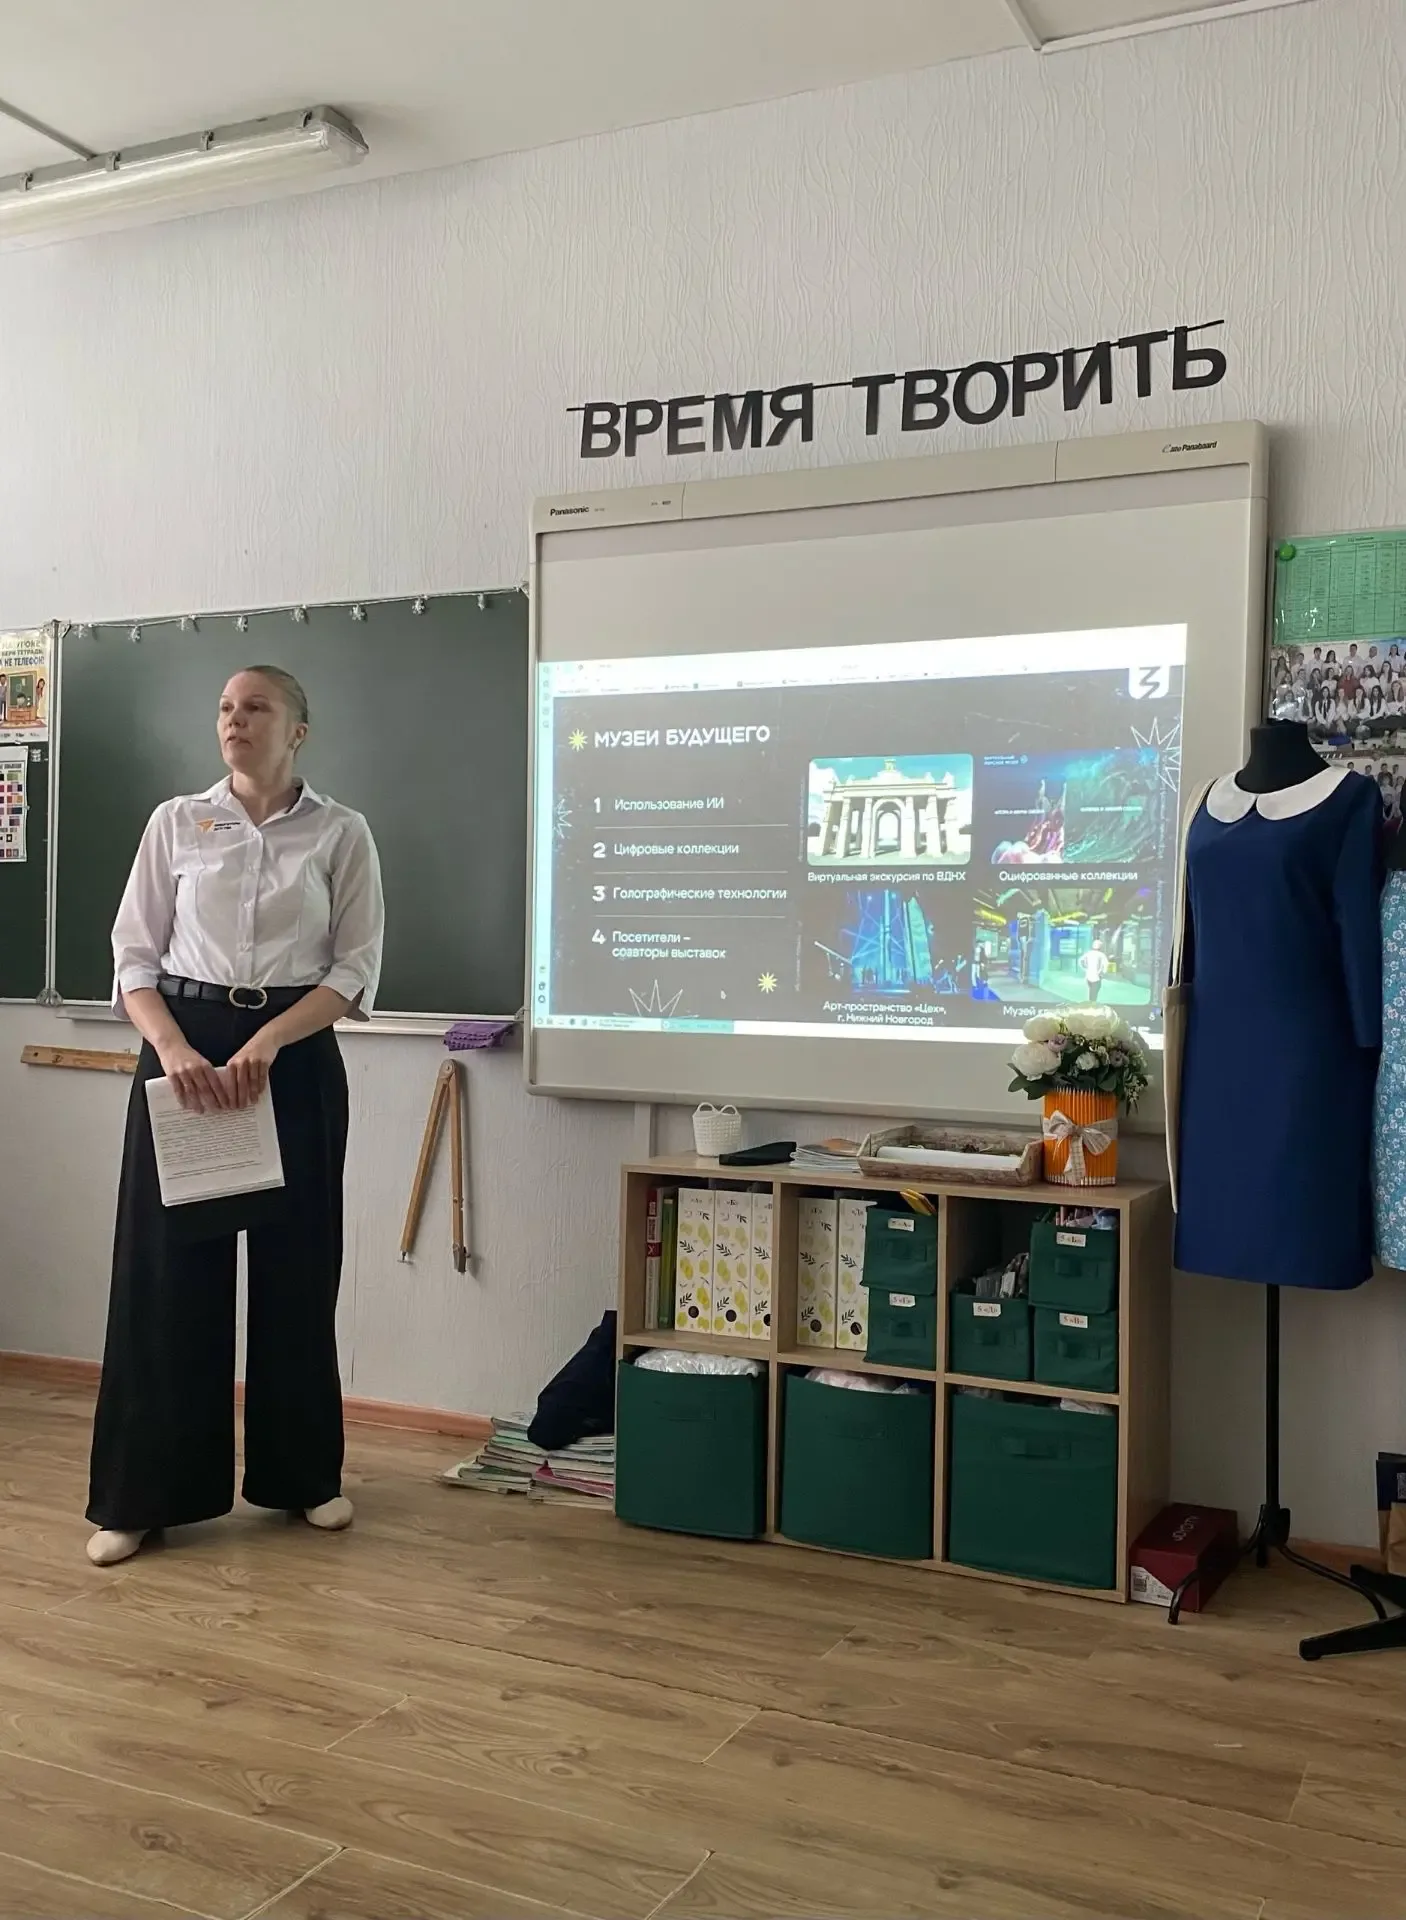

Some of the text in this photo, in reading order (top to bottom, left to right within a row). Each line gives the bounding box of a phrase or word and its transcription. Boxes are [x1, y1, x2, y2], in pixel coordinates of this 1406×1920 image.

[580, 325, 1228, 459] ВРЕМЯ ТВОРИТЬ
[549, 506, 590, 516] Panasonic
[594, 725, 771, 748] МУЗЕИ БУДУЩЕГО
[593, 797, 724, 813] 1 Использование ИИ
[592, 841, 740, 858] 2 Цифровые коллекции
[807, 871, 966, 883] Виртуальная экскурсия по ВДНХ
[999, 870, 1138, 882] Оцифрованные коллекции
[592, 885, 787, 901] 3 Голографические технологии
[591, 928, 606, 945] 4
[612, 930, 681, 943] Посетители
[612, 947, 727, 960] соавторы выставок
[823, 1000, 913, 1014] Арт-пространство
[1003, 1004, 1035, 1017] Музей
[846, 1013, 883, 1025] Нижний
[885, 1014, 934, 1026] Новгород
